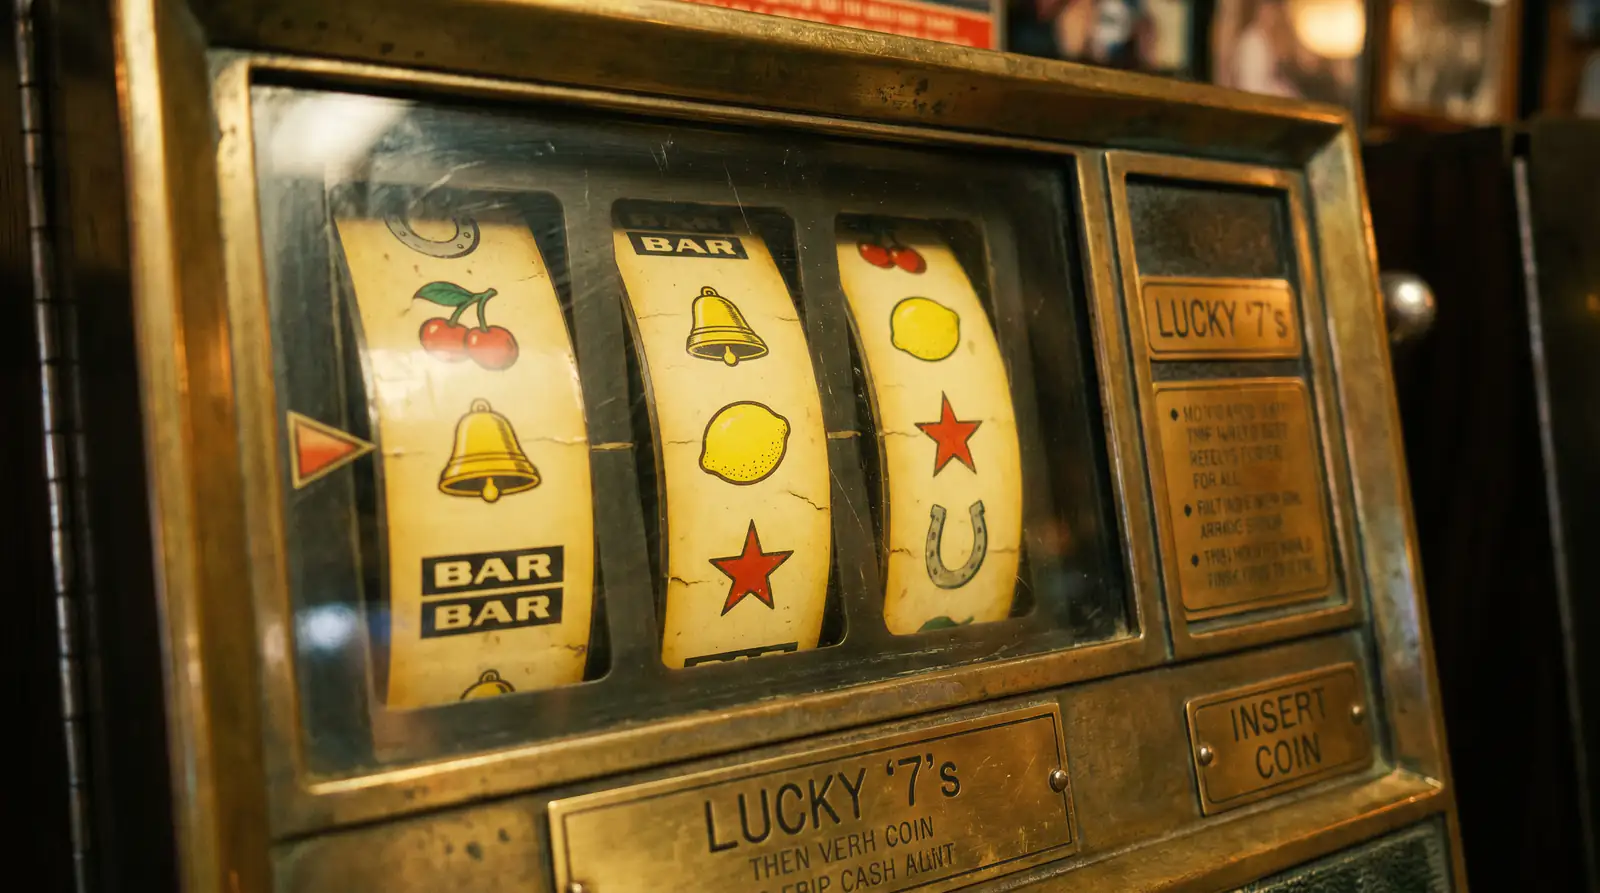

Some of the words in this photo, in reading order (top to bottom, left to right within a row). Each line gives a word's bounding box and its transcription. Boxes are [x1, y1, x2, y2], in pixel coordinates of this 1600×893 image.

[641, 236, 737, 255] BAR
[1155, 296, 1236, 339] LUCKY
[434, 553, 552, 588] BAR
[434, 595, 550, 631] BAR
[1230, 687, 1326, 742] INSERT
[1256, 732, 1321, 779] COIN
[704, 767, 867, 853] LUCKY
[749, 846, 810, 881] THEN
[818, 829, 876, 863] VERH
[885, 816, 933, 848] COIN
[841, 858, 896, 893] CASH
